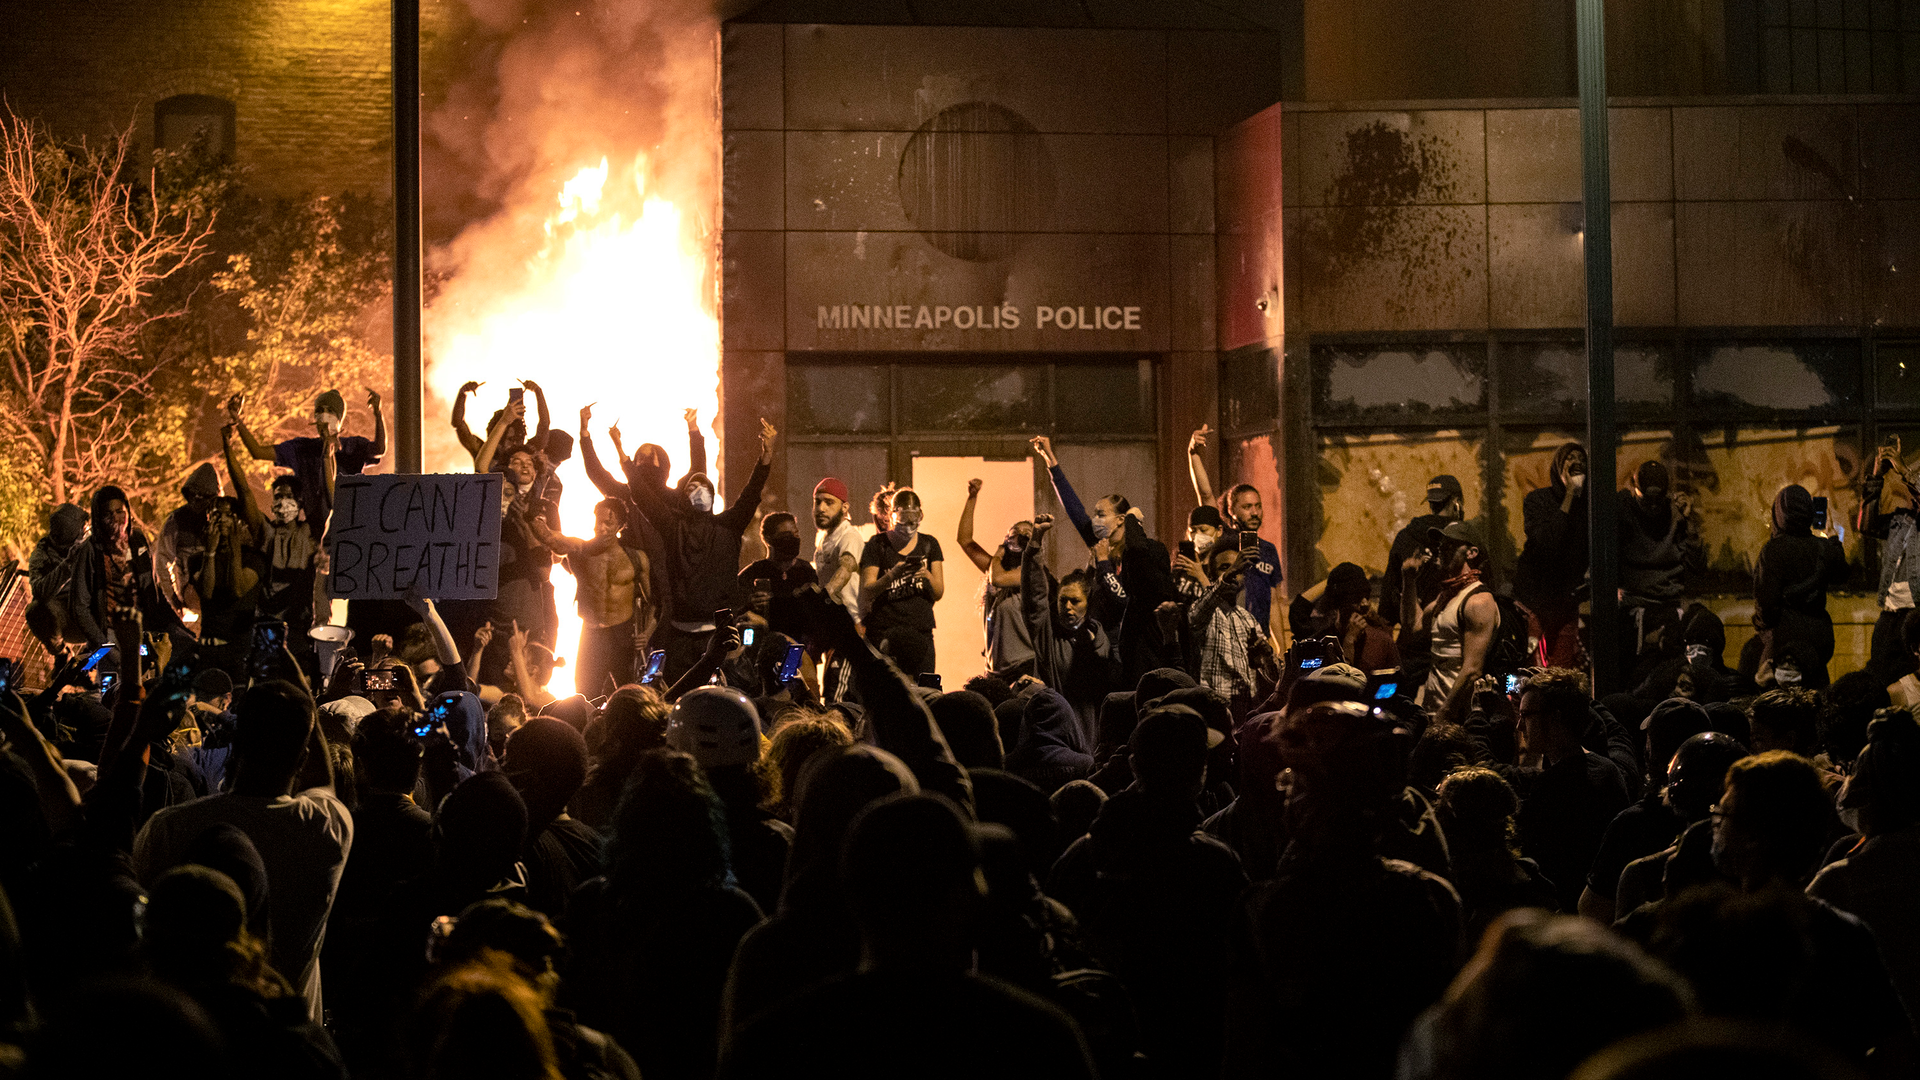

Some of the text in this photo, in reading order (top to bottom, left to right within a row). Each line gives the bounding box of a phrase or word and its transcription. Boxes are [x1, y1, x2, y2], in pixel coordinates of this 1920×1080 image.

[817, 305, 1142, 330] MINNEAPOLIS POLICE
[336, 479, 496, 537] I CAN'T
[333, 540, 492, 594] BREATHE
